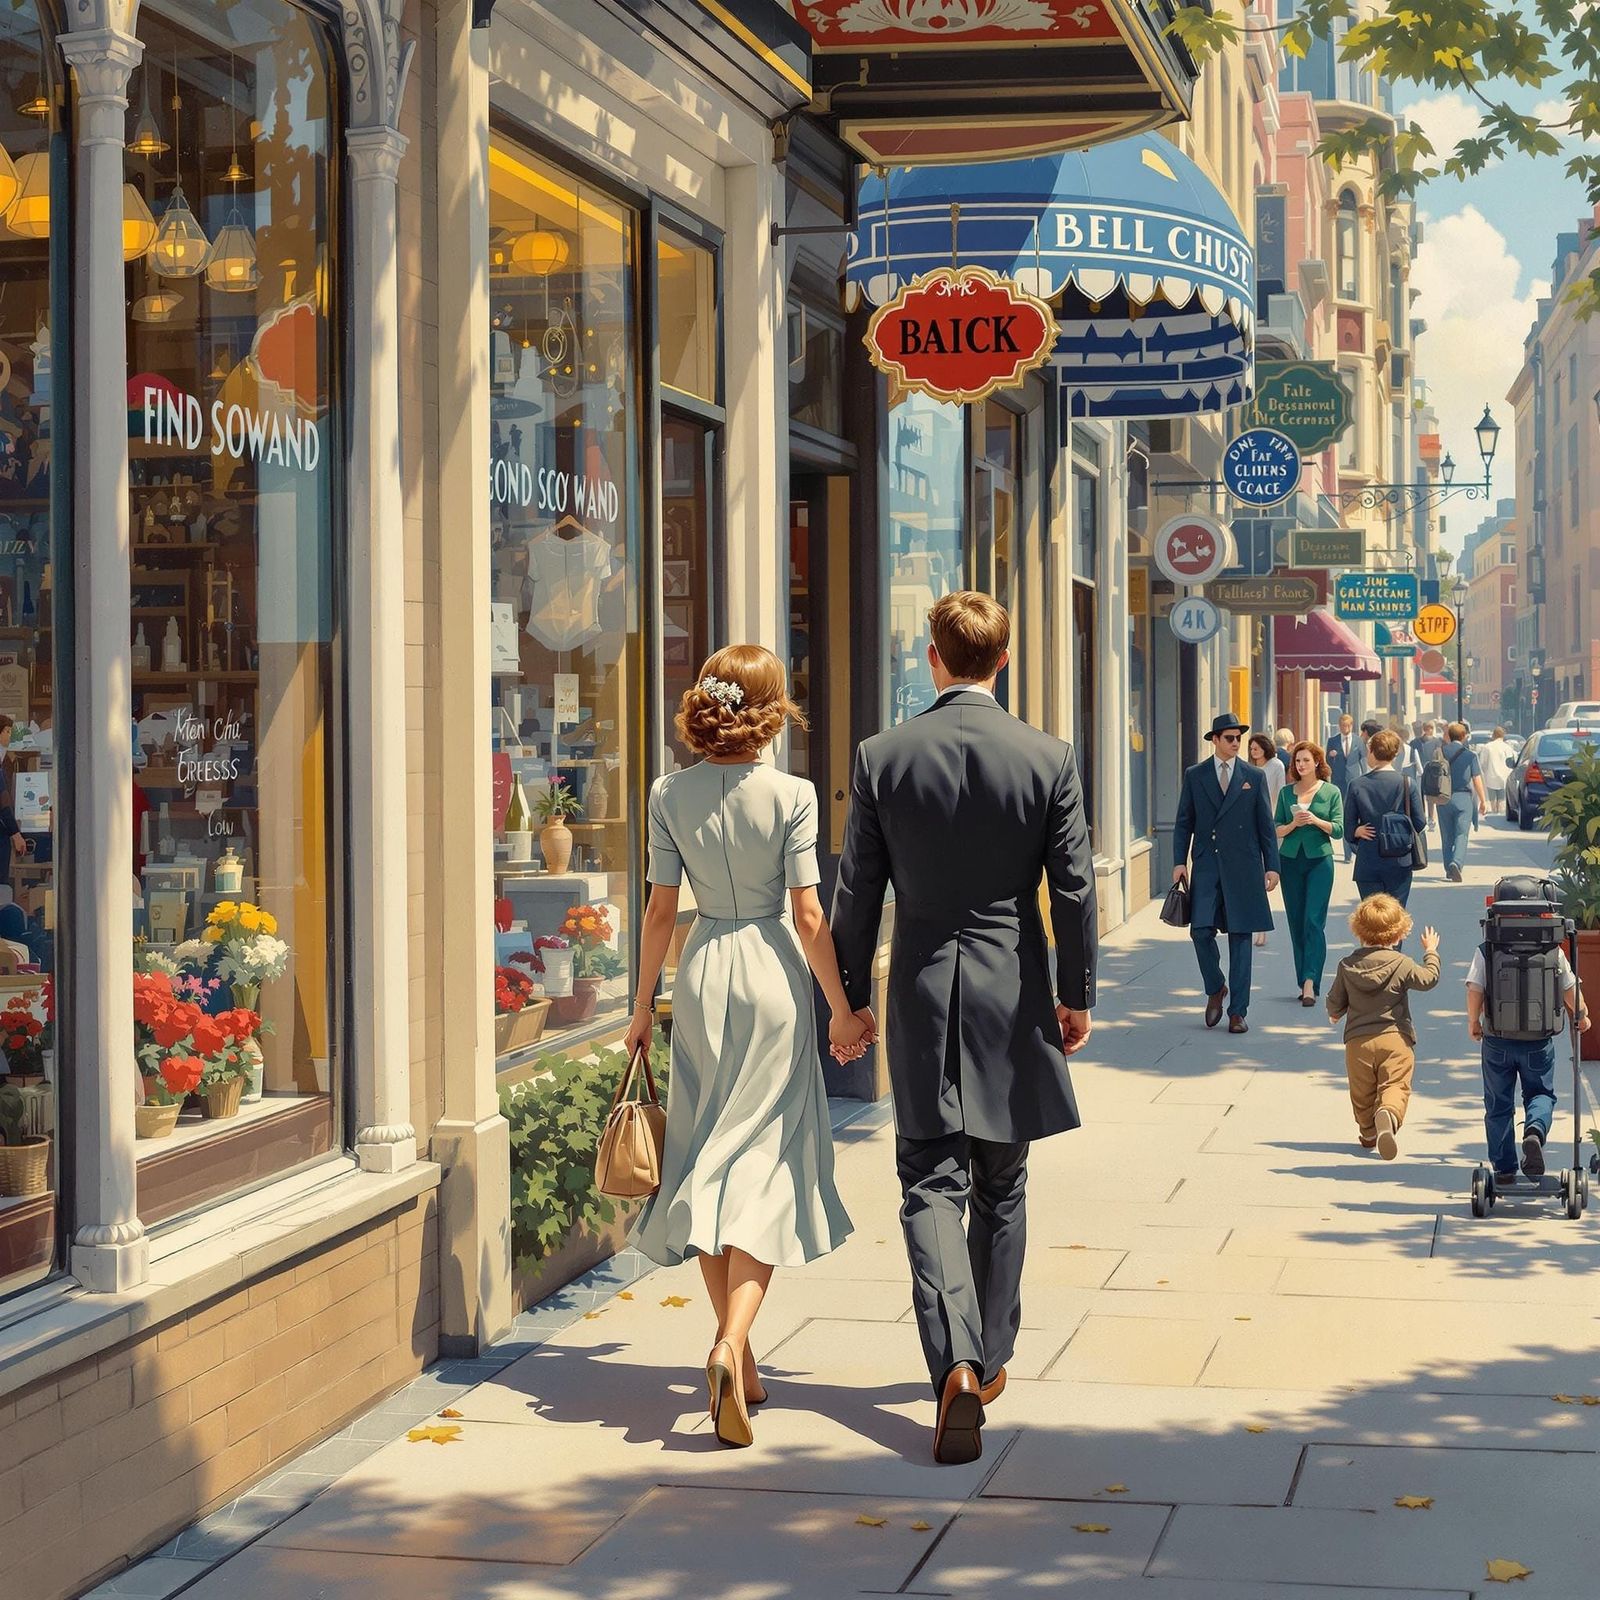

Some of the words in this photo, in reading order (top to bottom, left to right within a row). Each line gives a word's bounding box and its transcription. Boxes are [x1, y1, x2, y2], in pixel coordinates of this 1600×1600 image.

[1055, 213, 1155, 254] BELL
[899, 315, 1021, 355] BAICK
[144, 386, 203, 450] FIND
[211, 400, 320, 472] SOWAND
[1229, 436, 1257, 462] ONE
[573, 474, 619, 523] WAND
